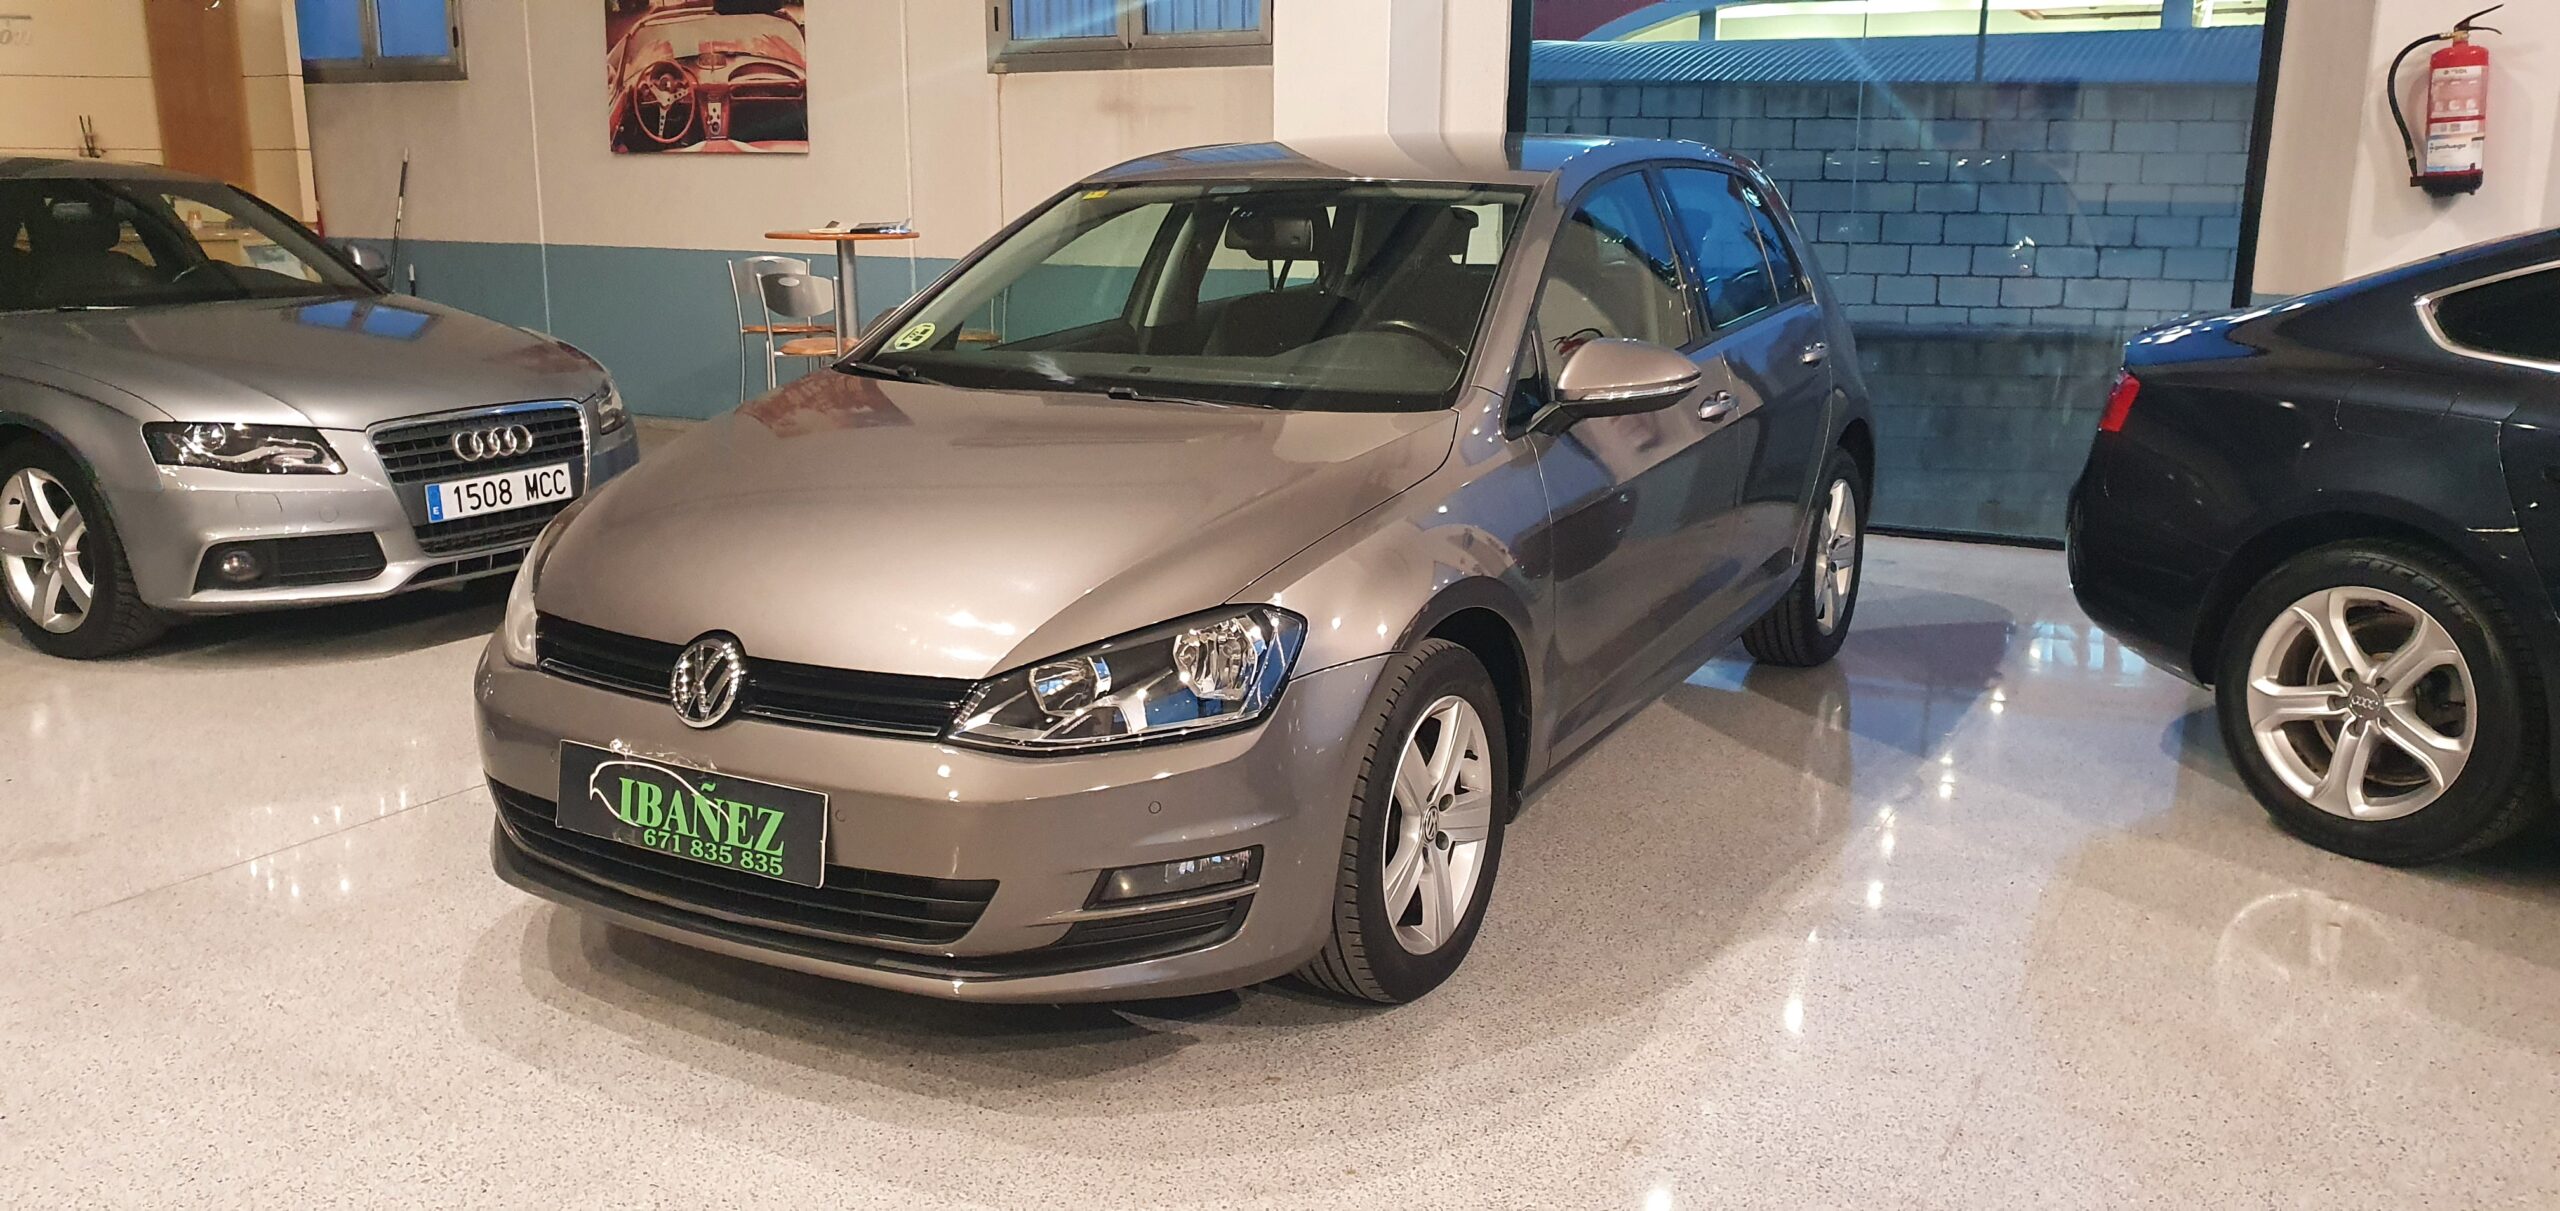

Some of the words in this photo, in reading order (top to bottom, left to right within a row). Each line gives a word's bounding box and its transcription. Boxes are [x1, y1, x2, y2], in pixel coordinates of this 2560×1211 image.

[432, 506, 440, 515] E
[454, 479, 513, 513] 1508
[524, 469, 566, 501] MCC
[617, 777, 785, 857] IBAÑEZ
[643, 828, 681, 853] 671
[690, 840, 733, 864] 835
[740, 851, 784, 876] 835
